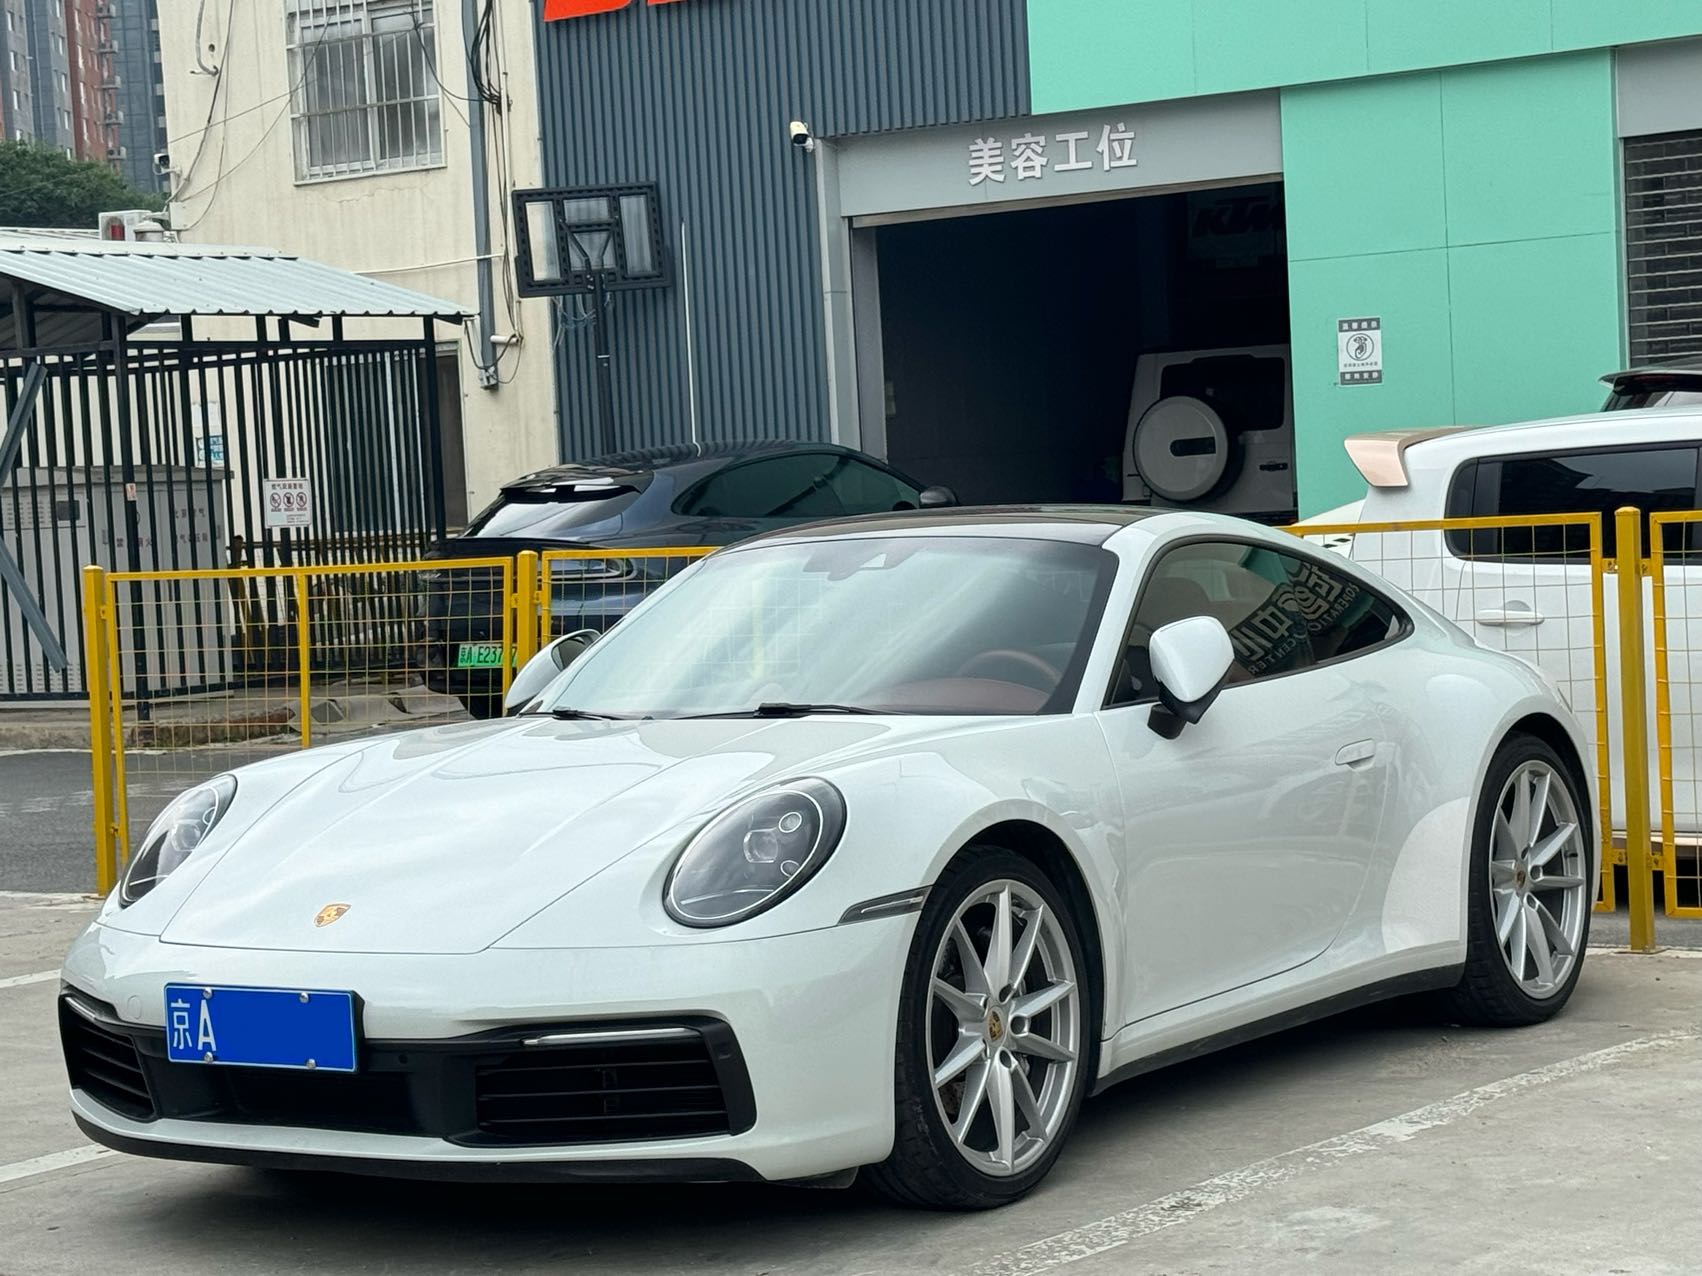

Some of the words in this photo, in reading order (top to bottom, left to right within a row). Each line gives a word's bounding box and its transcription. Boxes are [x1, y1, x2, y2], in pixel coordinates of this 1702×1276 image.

[968, 122, 1137, 186] 美容工位
[170, 998, 217, 1051] 京A
